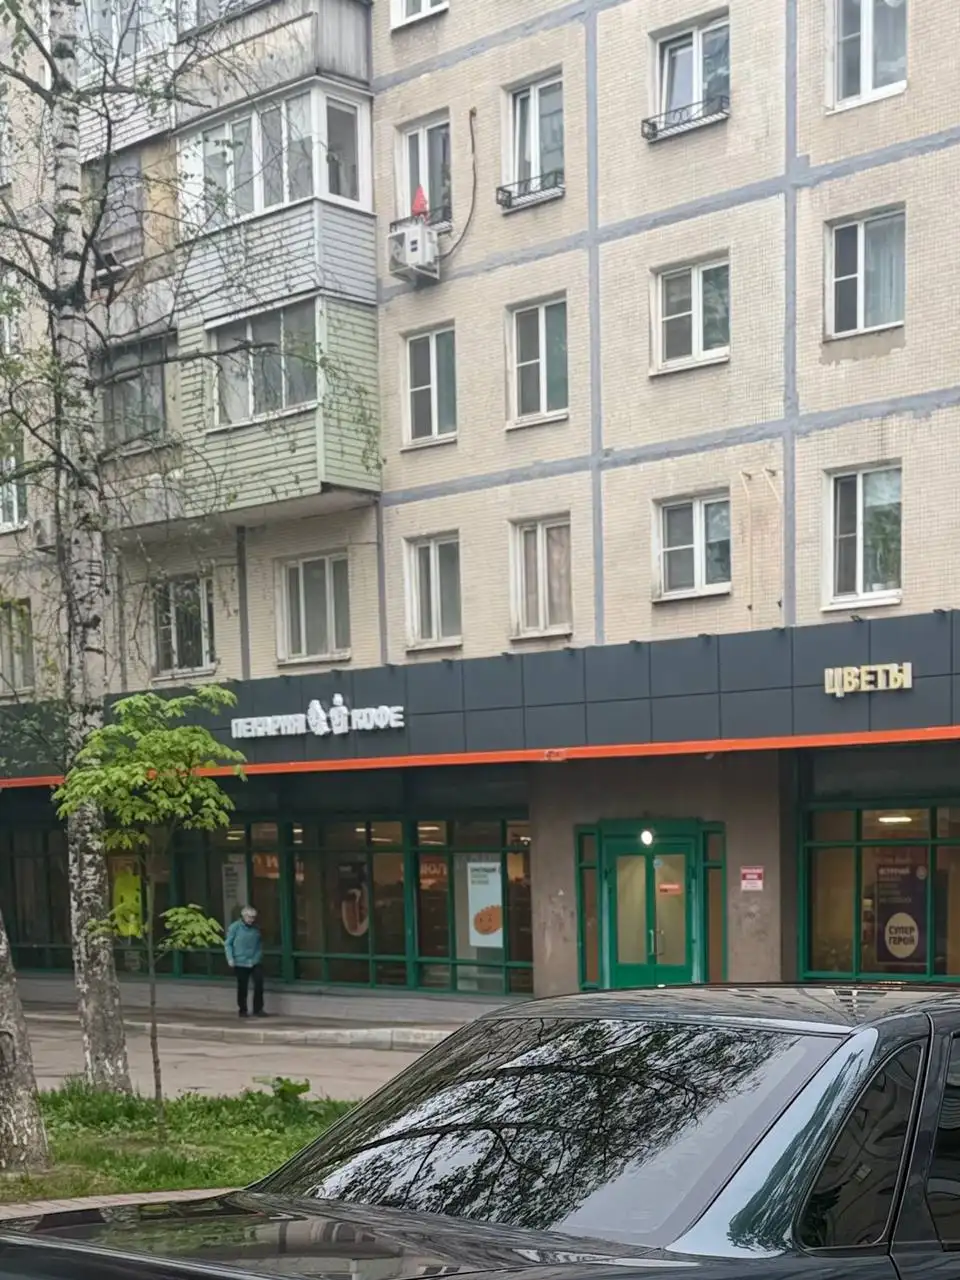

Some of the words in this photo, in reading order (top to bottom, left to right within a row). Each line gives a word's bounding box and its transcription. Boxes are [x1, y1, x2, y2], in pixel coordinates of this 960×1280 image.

[823, 662, 913, 698] ЦВЕТЫ
[231, 713, 307, 738] ПЕКАРНЯ
[351, 705, 405, 730] КОФЕ
[887, 935, 916, 946] ГЕРОЙ
[888, 925, 916, 936] СУПЕР
